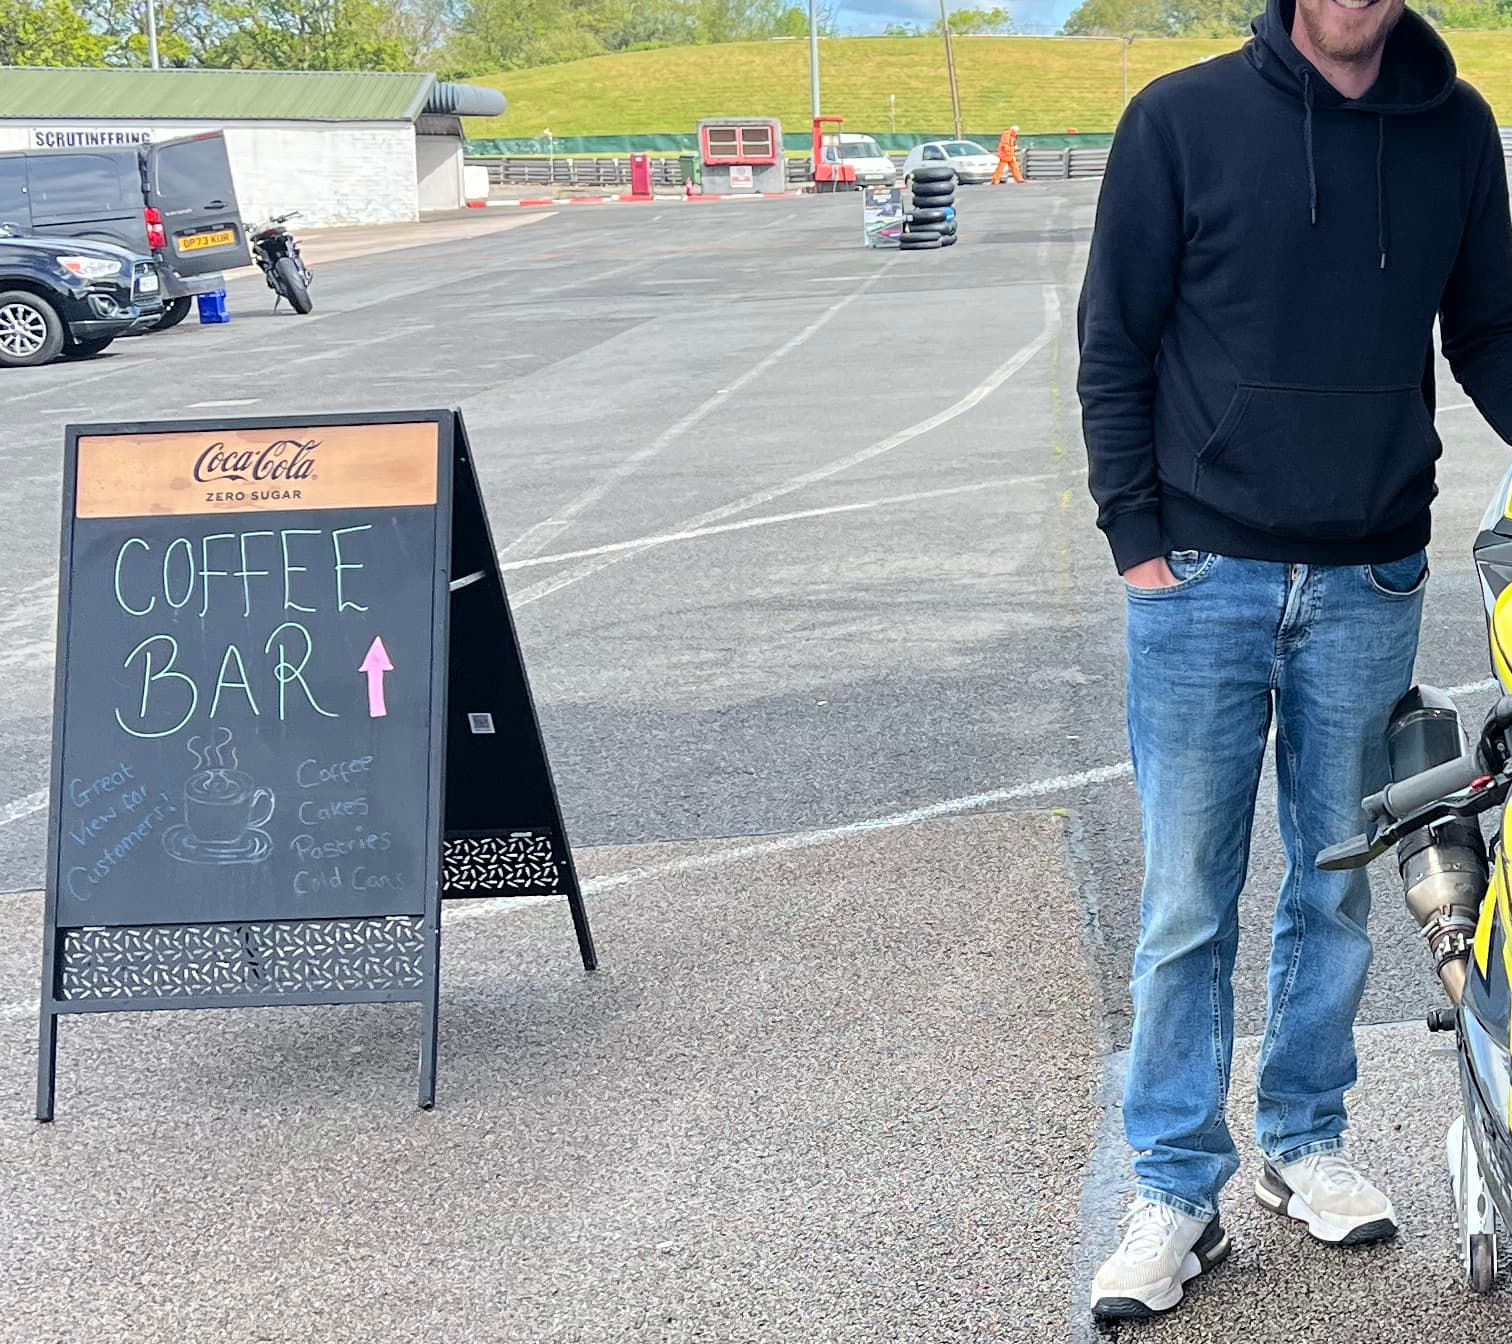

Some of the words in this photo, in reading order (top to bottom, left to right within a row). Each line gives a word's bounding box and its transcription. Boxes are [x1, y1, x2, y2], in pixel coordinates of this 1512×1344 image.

[193, 440, 321, 482] Coca-Cola
[206, 492, 246, 502] ZERO
[251, 490, 302, 500] SUGAR
[115, 524, 372, 616] COFFEE
[115, 622, 340, 738] BAR
[69, 762, 135, 807] Great
[296, 756, 373, 788] Coffee
[121, 784, 148, 813] for
[299, 797, 369, 825] Cakes
[290, 828, 392, 862] Pastries
[293, 865, 343, 895] Cold
